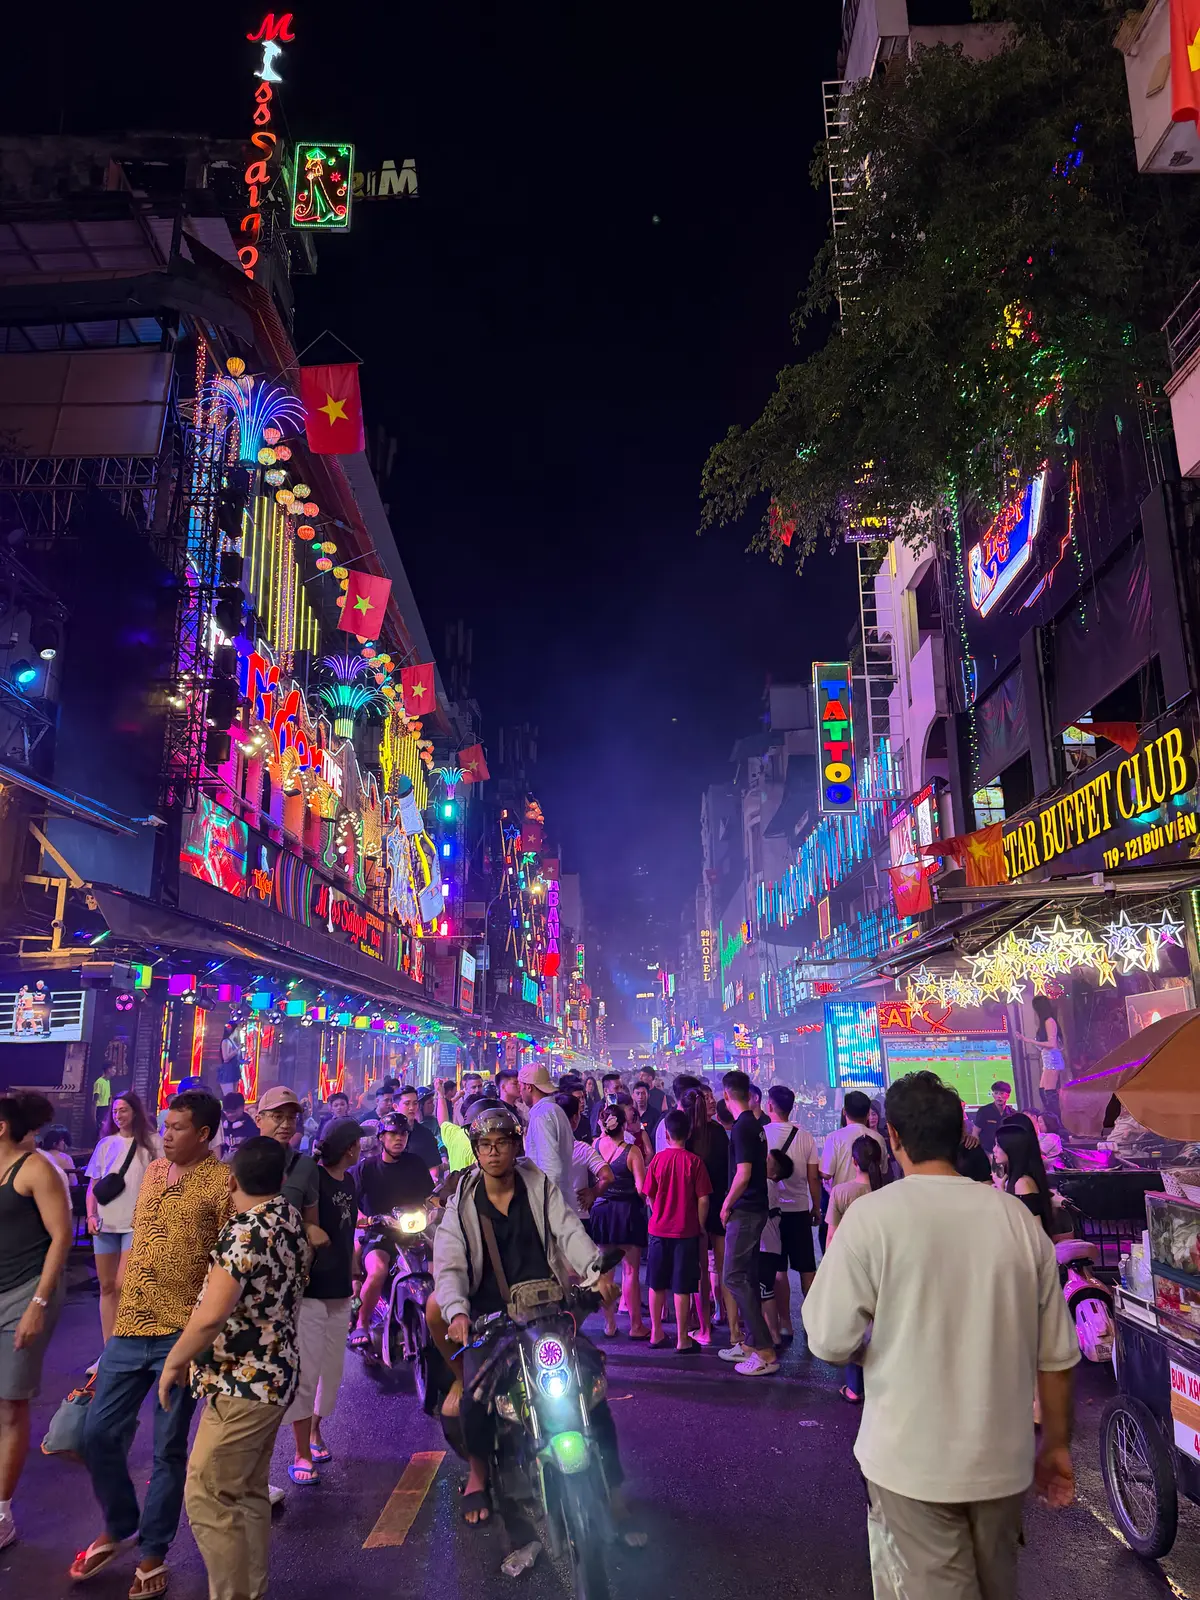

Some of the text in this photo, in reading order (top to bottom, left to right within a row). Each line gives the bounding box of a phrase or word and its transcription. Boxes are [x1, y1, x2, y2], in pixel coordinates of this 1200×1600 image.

[820, 679, 853, 804] TATTOO
[1039, 770, 1112, 861] BUFFET
[1116, 727, 1187, 819] CLUB
[1142, 823, 1164, 854] BÙI
[1163, 811, 1197, 844] VIÊN
[547, 880, 560, 954] ABANA
[702, 938, 711, 981] HOTEL
[1171, 1366, 1200, 1402] BÚN XÀ
[1194, 1434, 1200, 1456] 4
